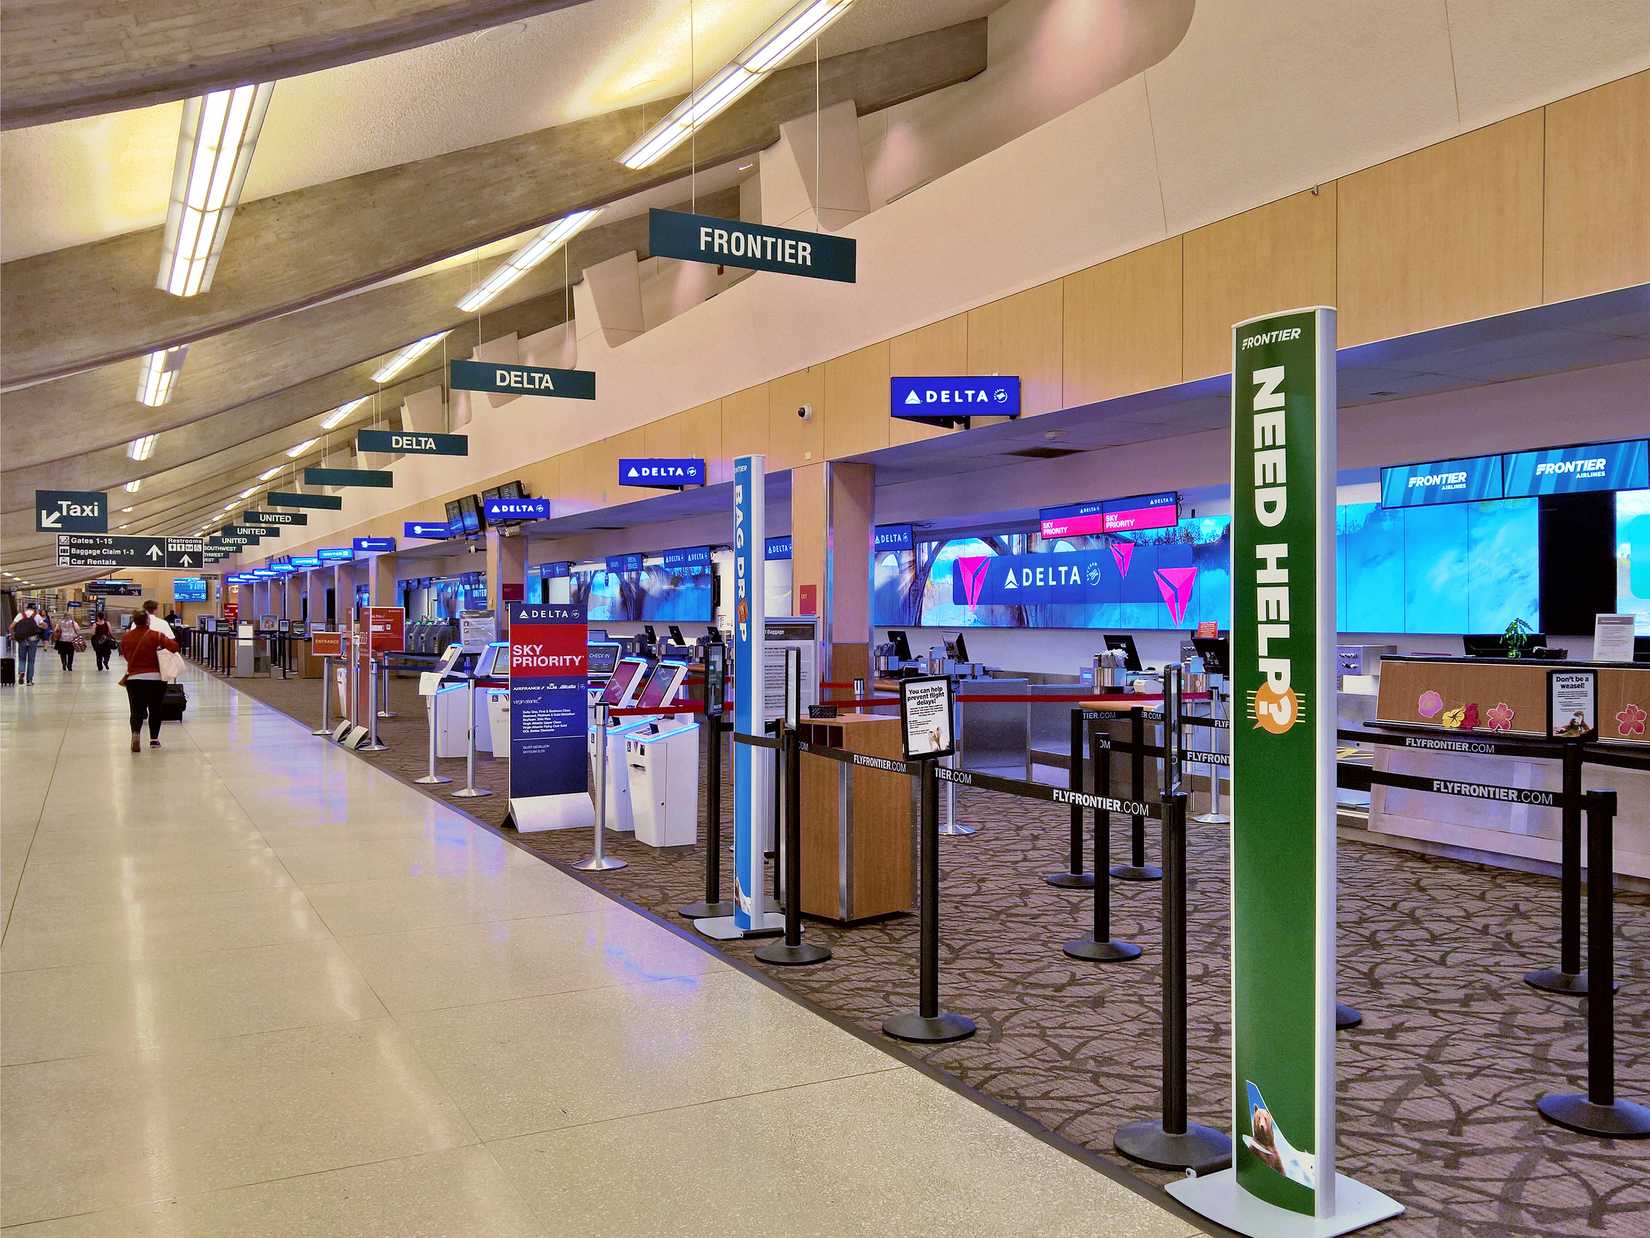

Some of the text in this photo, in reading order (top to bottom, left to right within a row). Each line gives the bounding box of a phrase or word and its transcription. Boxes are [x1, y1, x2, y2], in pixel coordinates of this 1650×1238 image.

[700, 227, 812, 266] FRONTIER
[1241, 328, 1302, 351] FRONTIER
[495, 370, 554, 390] DELTA
[926, 390, 988, 403] DELTA
[391, 435, 436, 451] DELTA
[641, 467, 684, 477] DELTA
[1536, 458, 1607, 476] FRONTIER
[1408, 471, 1467, 488] FRONTIER
[1576, 471, 1606, 479] AIRLINES
[58, 500, 99, 517] Taxi
[259, 513, 292, 523] UNITED
[1105, 513, 1119, 521] SKY
[1105, 519, 1135, 529] PRIORITY
[236, 527, 267, 536] UNITED
[1042, 526, 1068, 535] PRIORITY
[70, 537, 94, 545] Gates
[880, 533, 902, 543] DELTA
[70, 547, 101, 556] Baggage
[772, 545, 788, 554] DELTA
[1252, 366, 1292, 727] NEED HELP?
[70, 557, 117, 566] Car Rentals
[1022, 565, 1081, 587] DELTA
[531, 610, 569, 618] DELTA
[512, 644, 543, 656] SKY
[512, 655, 582, 668] PRIORITY
[929, 691, 944, 699] flight
[916, 698, 937, 706] delays!
[1405, 737, 1495, 754] FLYFRONTIER.COM
[853, 754, 907, 773] FLYFRONTIER.COM
[934, 767, 972, 785] TIER.COM
[1433, 780, 1553, 806] FLYFRONTIER.COM
[1052, 789, 1150, 817] FLYFRONTIER.COM
